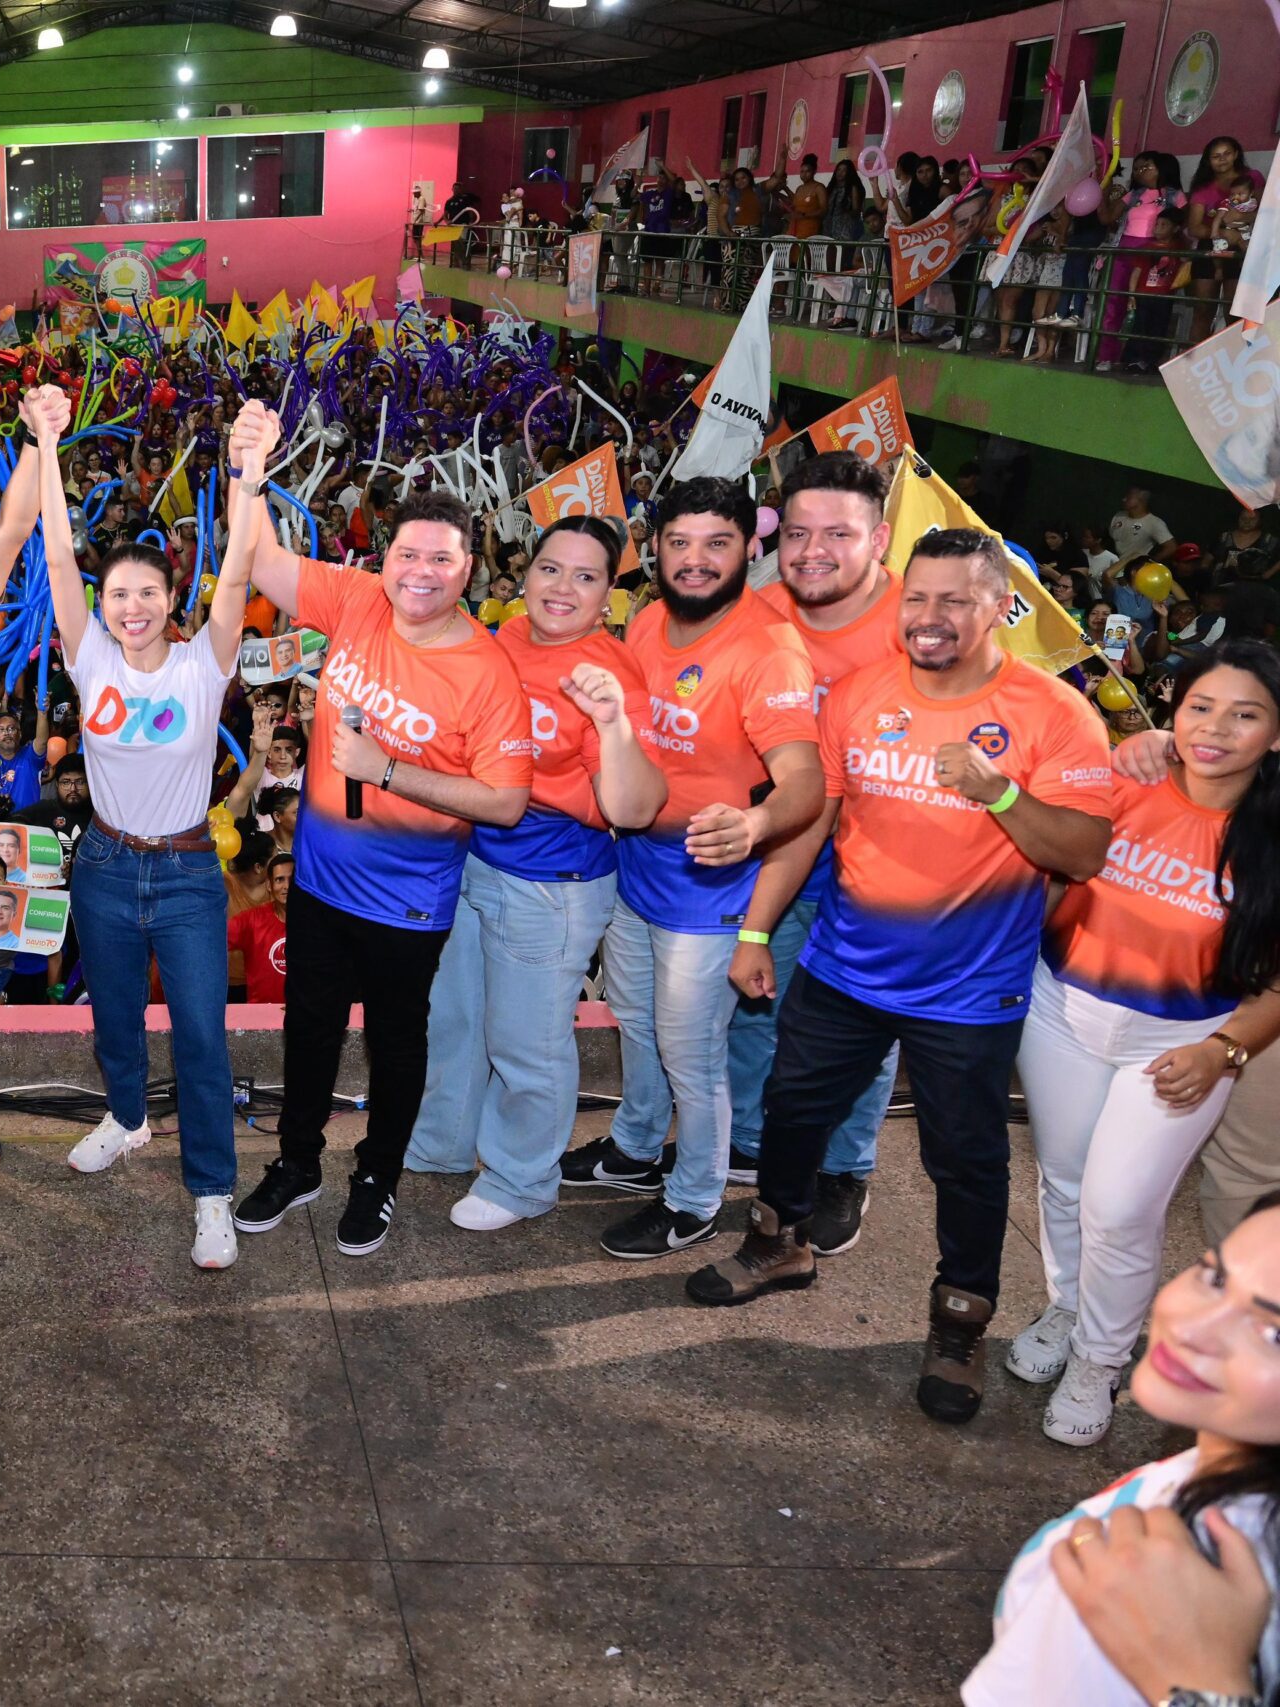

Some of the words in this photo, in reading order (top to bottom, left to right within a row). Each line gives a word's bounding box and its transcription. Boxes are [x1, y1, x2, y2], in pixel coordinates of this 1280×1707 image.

[898, 222, 949, 250] DAVID
[901, 238, 951, 280] 70
[54, 272, 93, 299] 27123
[825, 424, 843, 451] RENAT
[836, 405, 882, 466] 70
[869, 395, 898, 453] DAVID
[552, 467, 593, 519] 70
[585, 459, 607, 516] DAVID
[85, 685, 189, 743] D70
[371, 724, 423, 757] JUNIOR
[973, 734, 1006, 753] 70
[862, 780, 927, 803] RENATO
[30, 844, 59, 854] CONFIRMA
[29, 908, 63, 919] CONFIRMA
[1158, 890, 1225, 921] JUNIOR
